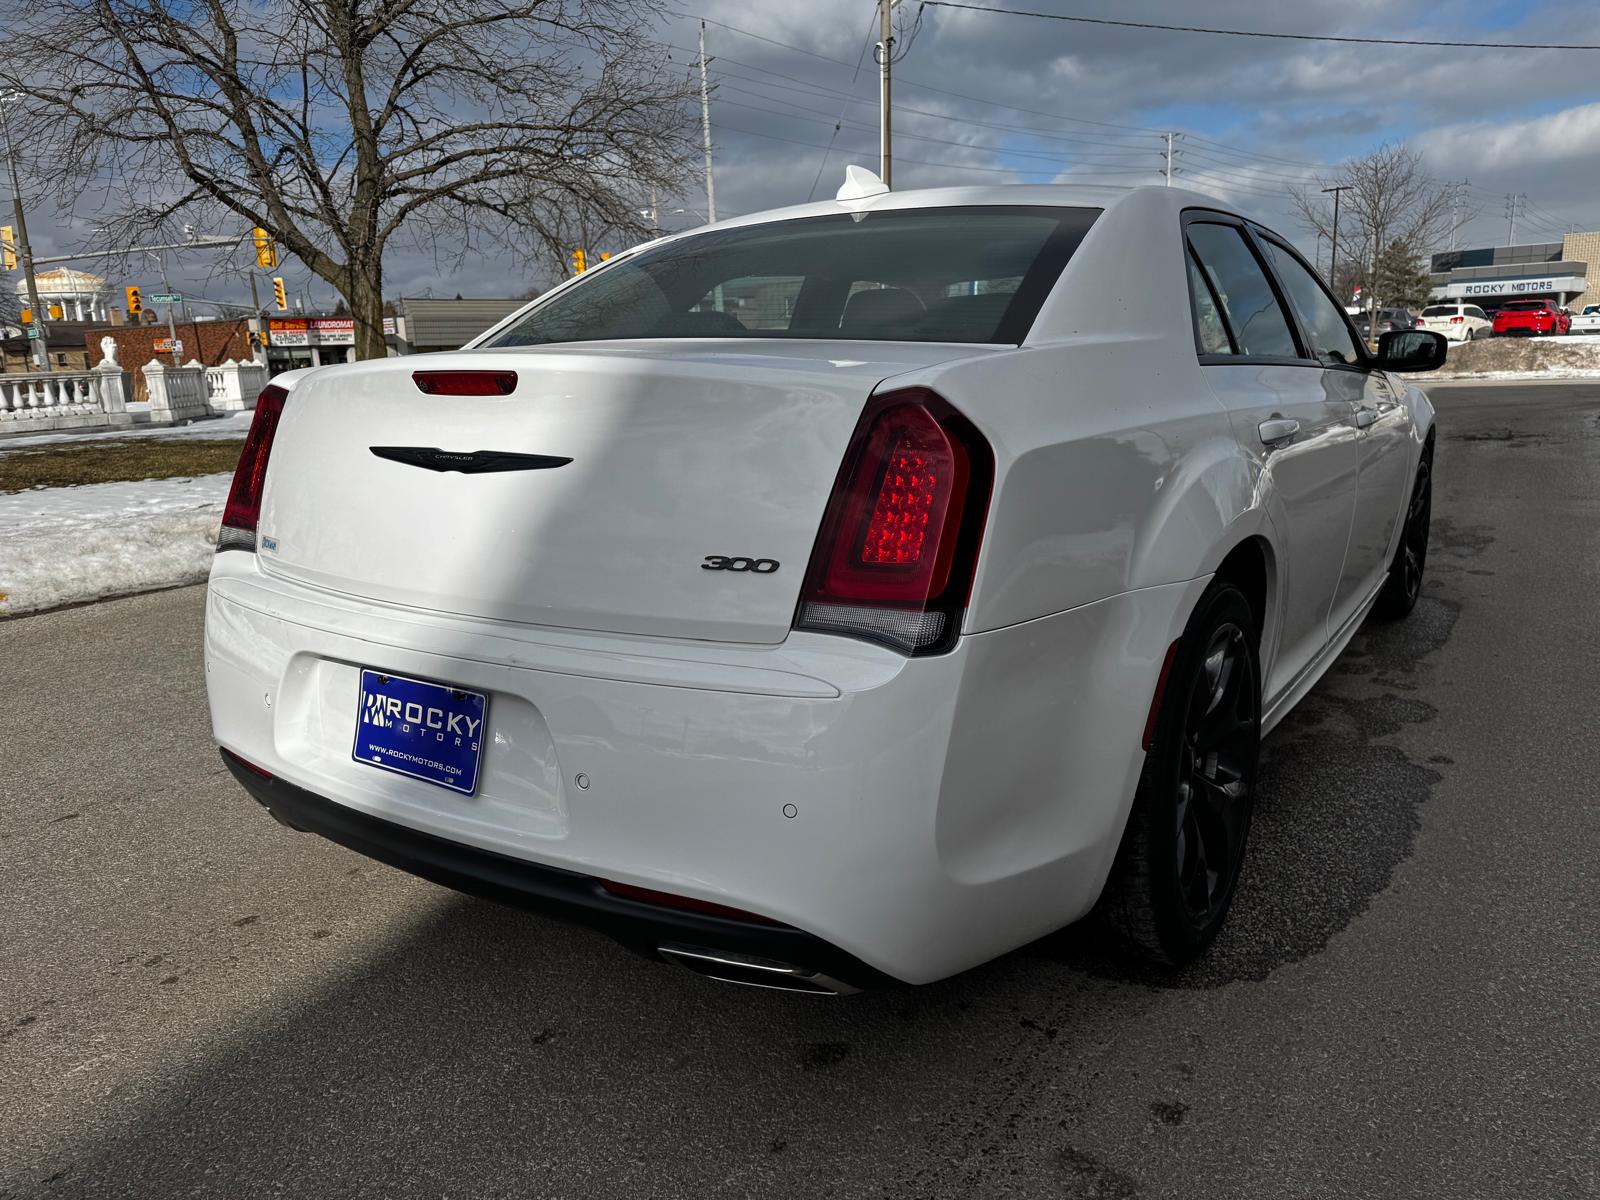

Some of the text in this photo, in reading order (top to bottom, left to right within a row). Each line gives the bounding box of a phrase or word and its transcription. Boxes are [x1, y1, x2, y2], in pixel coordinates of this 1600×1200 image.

[1465, 281, 1553, 294] ROCKY MOTORS
[270, 321, 308, 330] Self Service
[310, 320, 354, 329] LAUNDROMAT
[701, 555, 780, 573] 300
[386, 697, 480, 737] ROCKY
[385, 718, 478, 751] MOTORS
[368, 743, 462, 776] WWW.ROCKYMOTORS.COM
